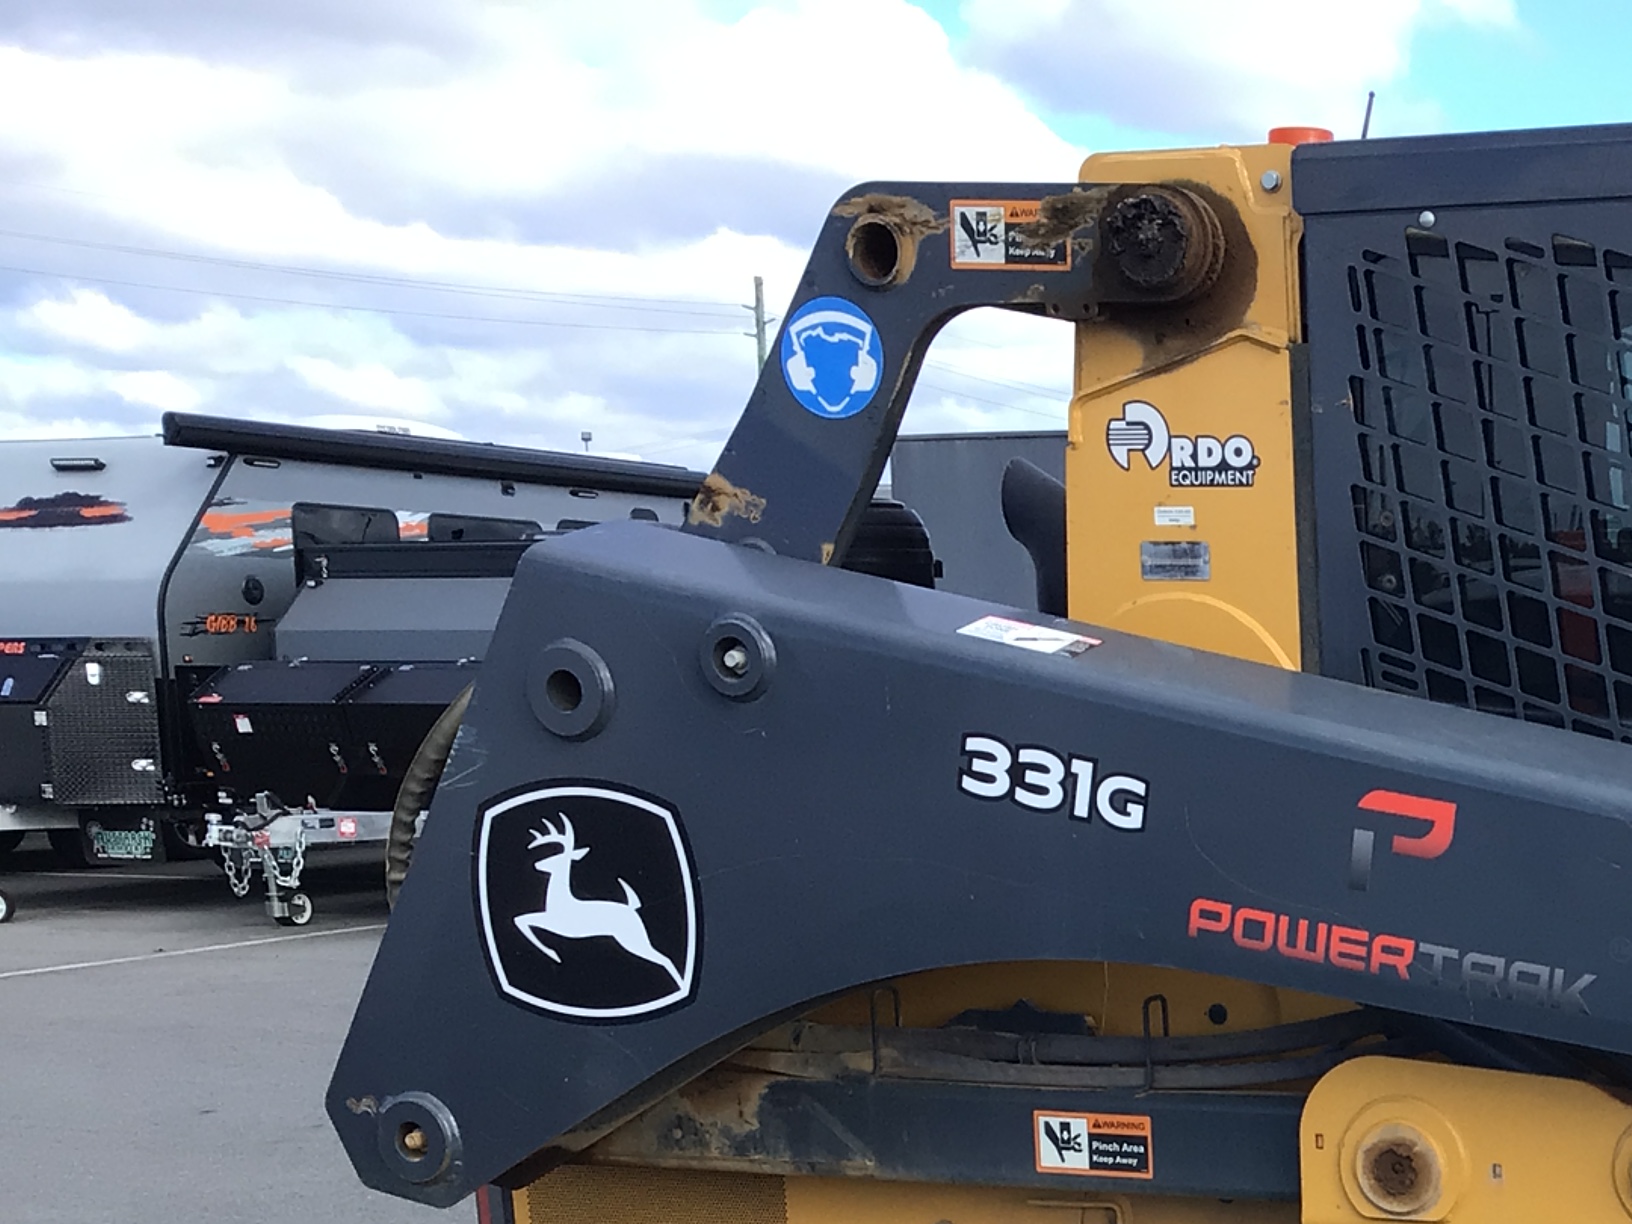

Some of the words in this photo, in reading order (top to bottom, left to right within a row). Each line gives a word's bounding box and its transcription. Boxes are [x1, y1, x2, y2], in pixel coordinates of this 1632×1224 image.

[1171, 470, 1254, 486] EQUIPMENT
[243, 615, 258, 633] 16
[960, 736, 1148, 831] 331G
[1101, 1121, 1145, 1131] WARNING
[1091, 1140, 1120, 1152] Pinch
[1122, 1142, 1145, 1154] Area
[1091, 1154, 1114, 1165] Keep
[1115, 1155, 1138, 1168] Away
